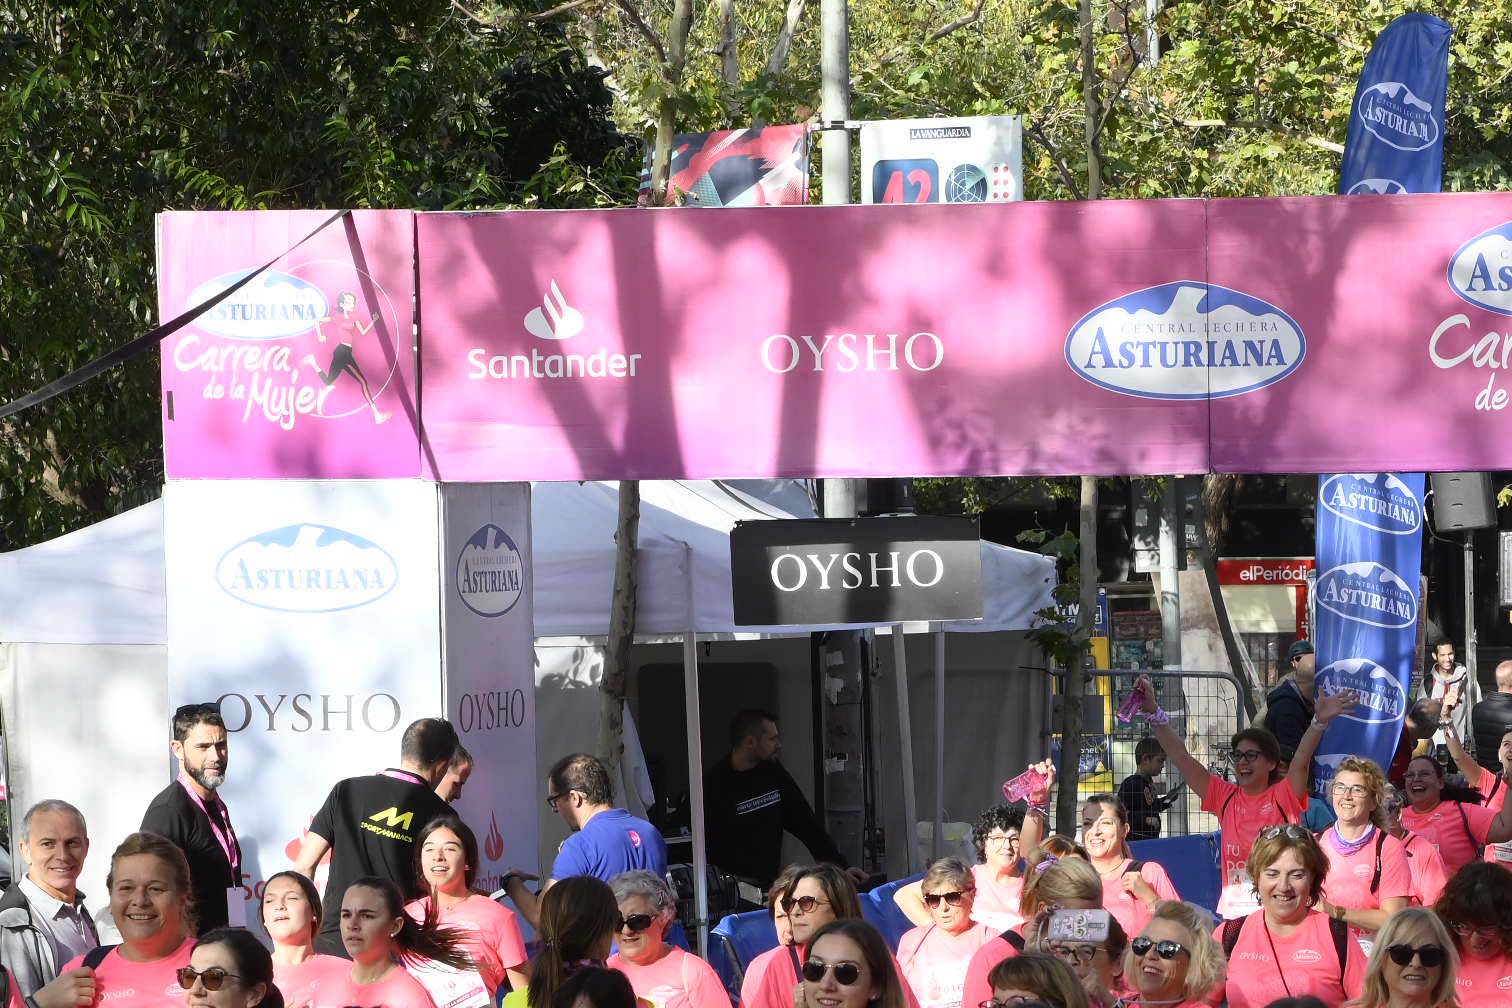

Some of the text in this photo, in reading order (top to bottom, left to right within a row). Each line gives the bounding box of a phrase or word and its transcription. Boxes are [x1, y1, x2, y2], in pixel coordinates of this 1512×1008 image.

[1084, 327, 1287, 369] ASTURIANA
[1121, 321, 1279, 334] CENTRAL LECHERA
[173, 335, 291, 371] Carrera
[468, 348, 642, 379] Santander
[760, 332, 945, 373] OYSHO
[203, 370, 336, 430] de la Mujer
[1475, 373, 1509, 411] de
[1328, 482, 1416, 527] ASTURIANA
[231, 558, 385, 590] ASTURIANA
[461, 563, 520, 594] ASTURIANA
[770, 549, 944, 592] OYSHO
[1323, 577, 1411, 621] ASTURIANA
[217, 692, 402, 733] OYSHO
[459, 688, 525, 733] OYSHO
